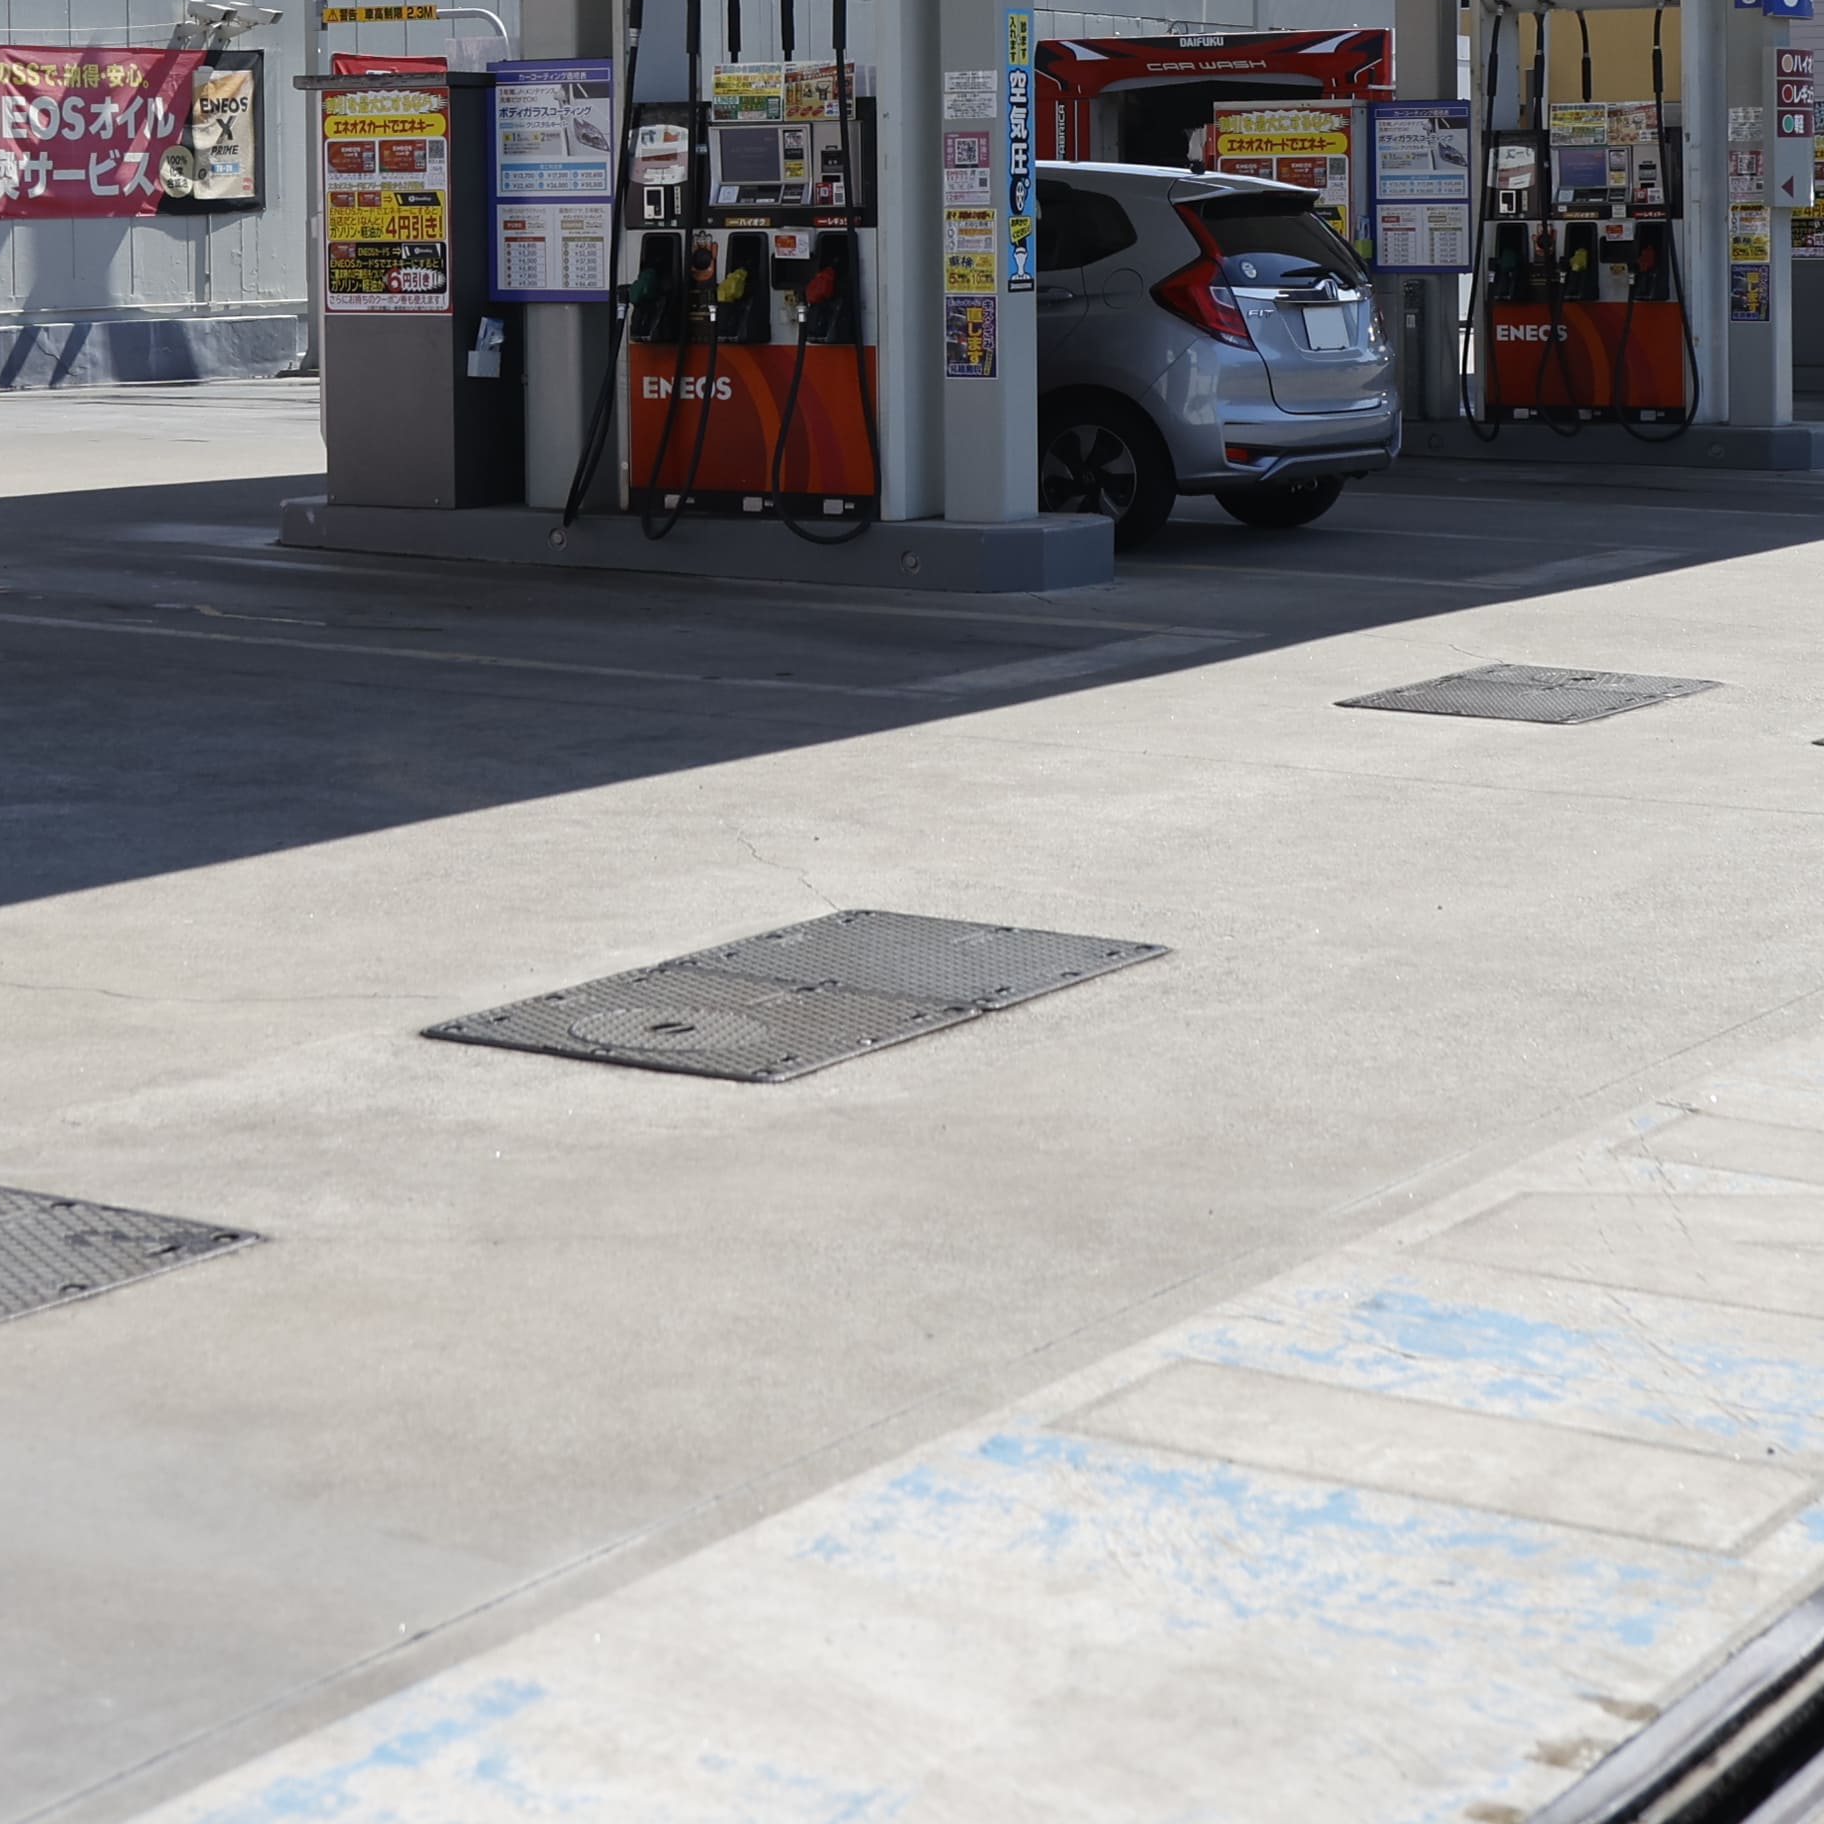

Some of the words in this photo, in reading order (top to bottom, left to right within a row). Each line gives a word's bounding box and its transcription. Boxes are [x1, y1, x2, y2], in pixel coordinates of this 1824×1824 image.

[1179, 36, 1224, 48] DAIFUKU
[1146, 62, 1196, 73] CAR
[1200, 60, 1267, 71] WASH
[199, 96, 249, 114] ENEOS
[216, 116, 236, 144] X
[333, 119, 435, 134] エネオスカードでエネキー
[1010, 70, 1027, 176] 空気圧
[210, 145, 240, 156] PRIME
[1228, 138, 1336, 152] エネオスカードでエネキー
[386, 215, 443, 240] 4円引き!
[1247, 308, 1274, 319] FIT
